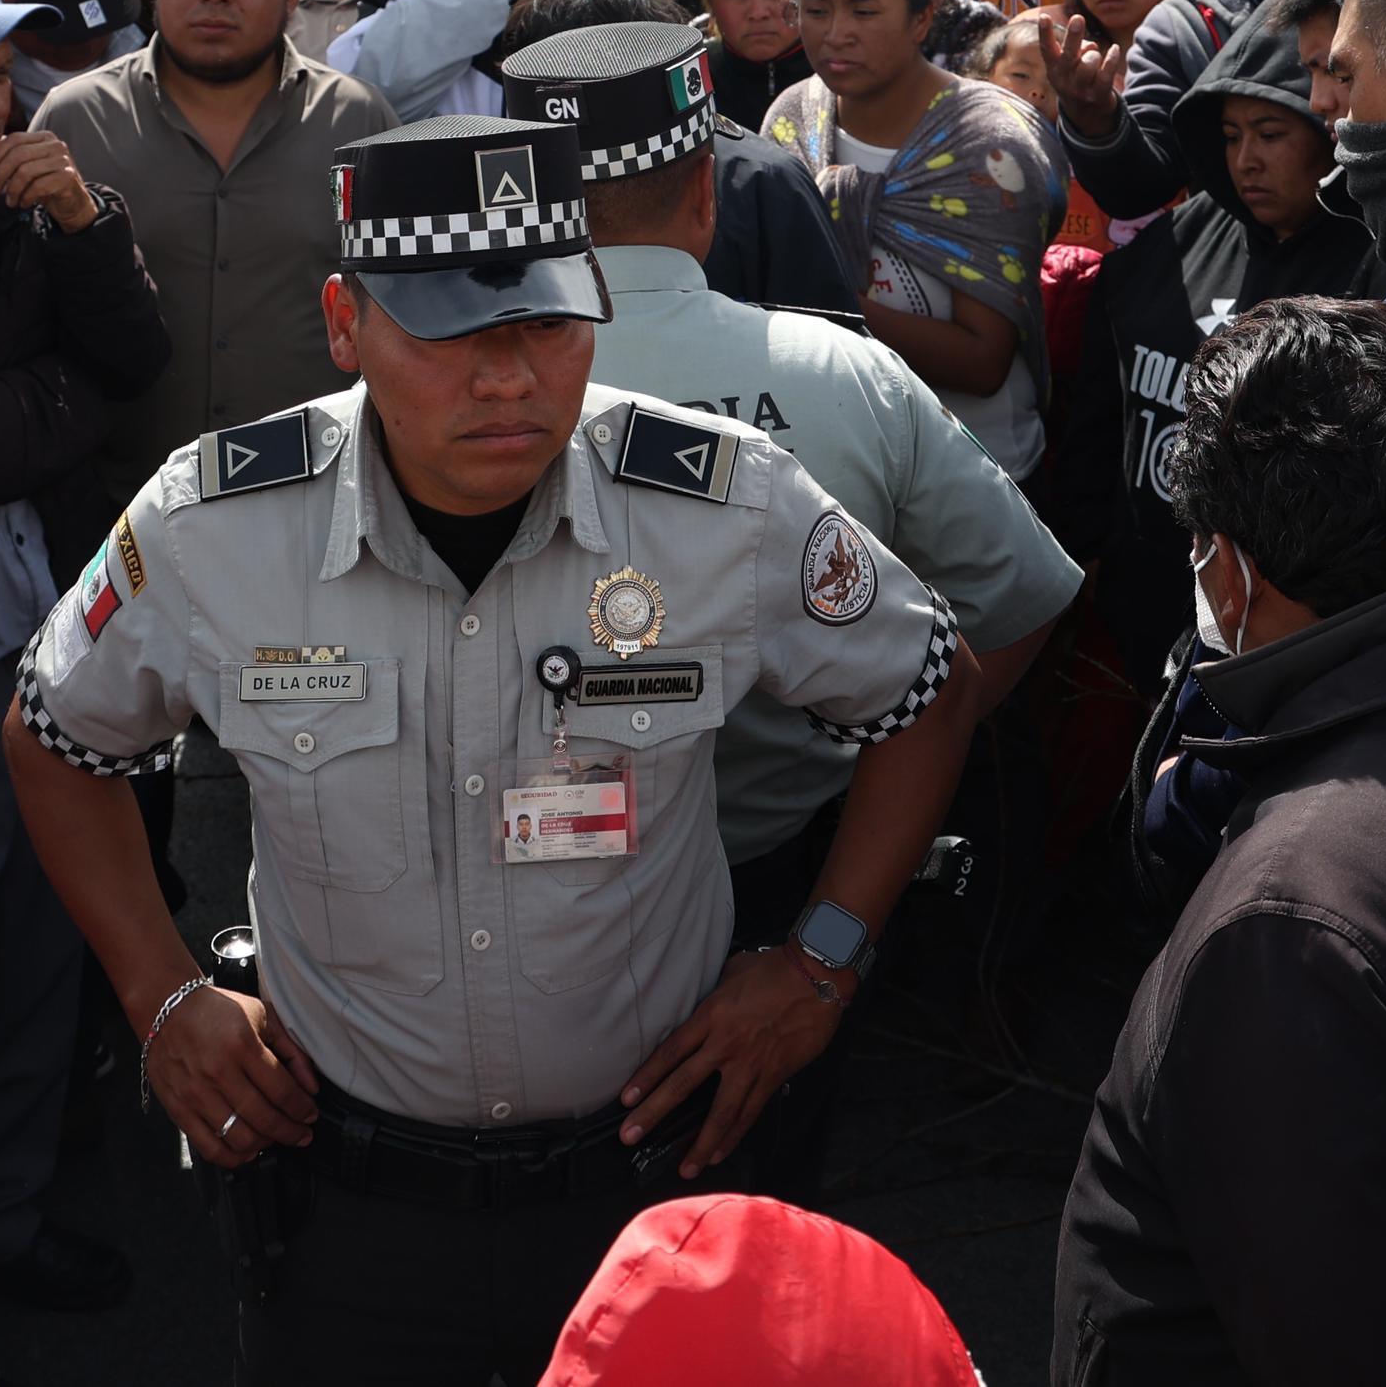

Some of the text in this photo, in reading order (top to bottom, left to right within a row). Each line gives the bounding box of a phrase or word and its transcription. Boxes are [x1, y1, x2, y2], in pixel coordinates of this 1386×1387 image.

[545, 97, 580, 120] GN
[253, 675, 351, 690] DE LA CRUZ
[585, 676, 694, 698] GUARDIA NACIONAL
